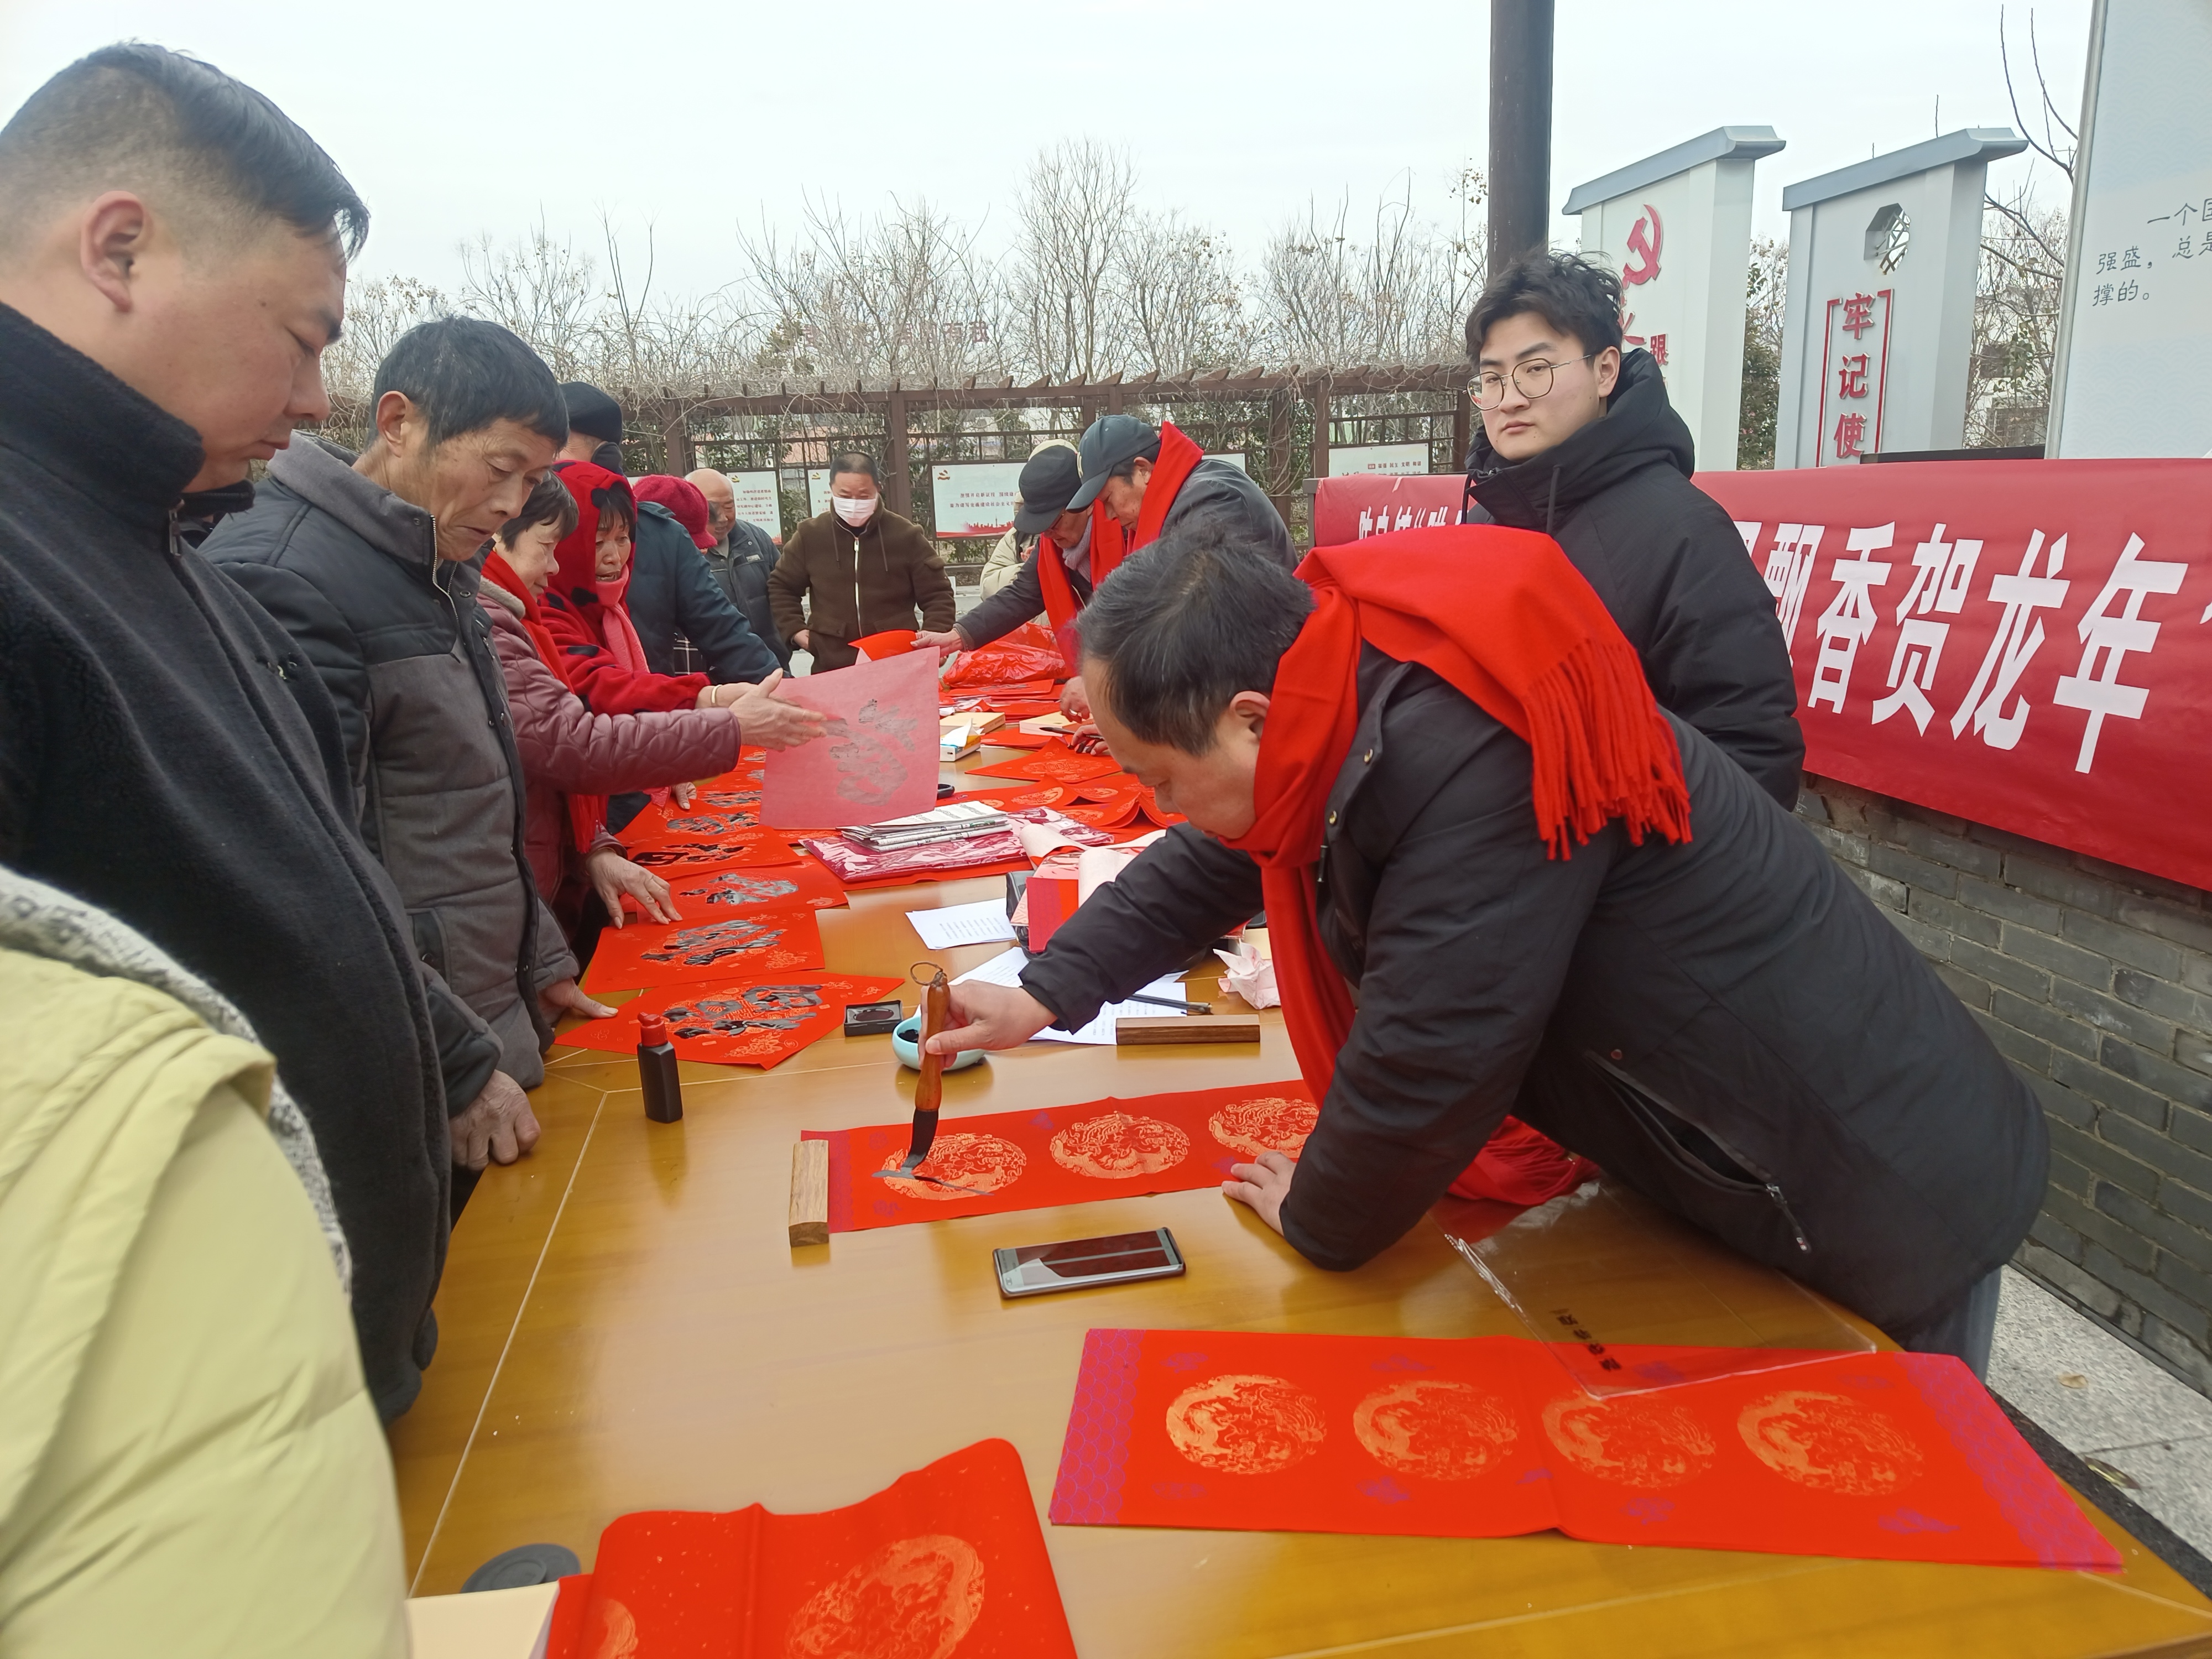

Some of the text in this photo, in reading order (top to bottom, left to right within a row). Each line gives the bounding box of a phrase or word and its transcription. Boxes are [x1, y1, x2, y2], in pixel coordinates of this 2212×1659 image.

[1833, 291, 1876, 460] 牢记使
[2092, 279, 2150, 307] 撑的。
[1733, 521, 2212, 774] 飘香贺龙年
